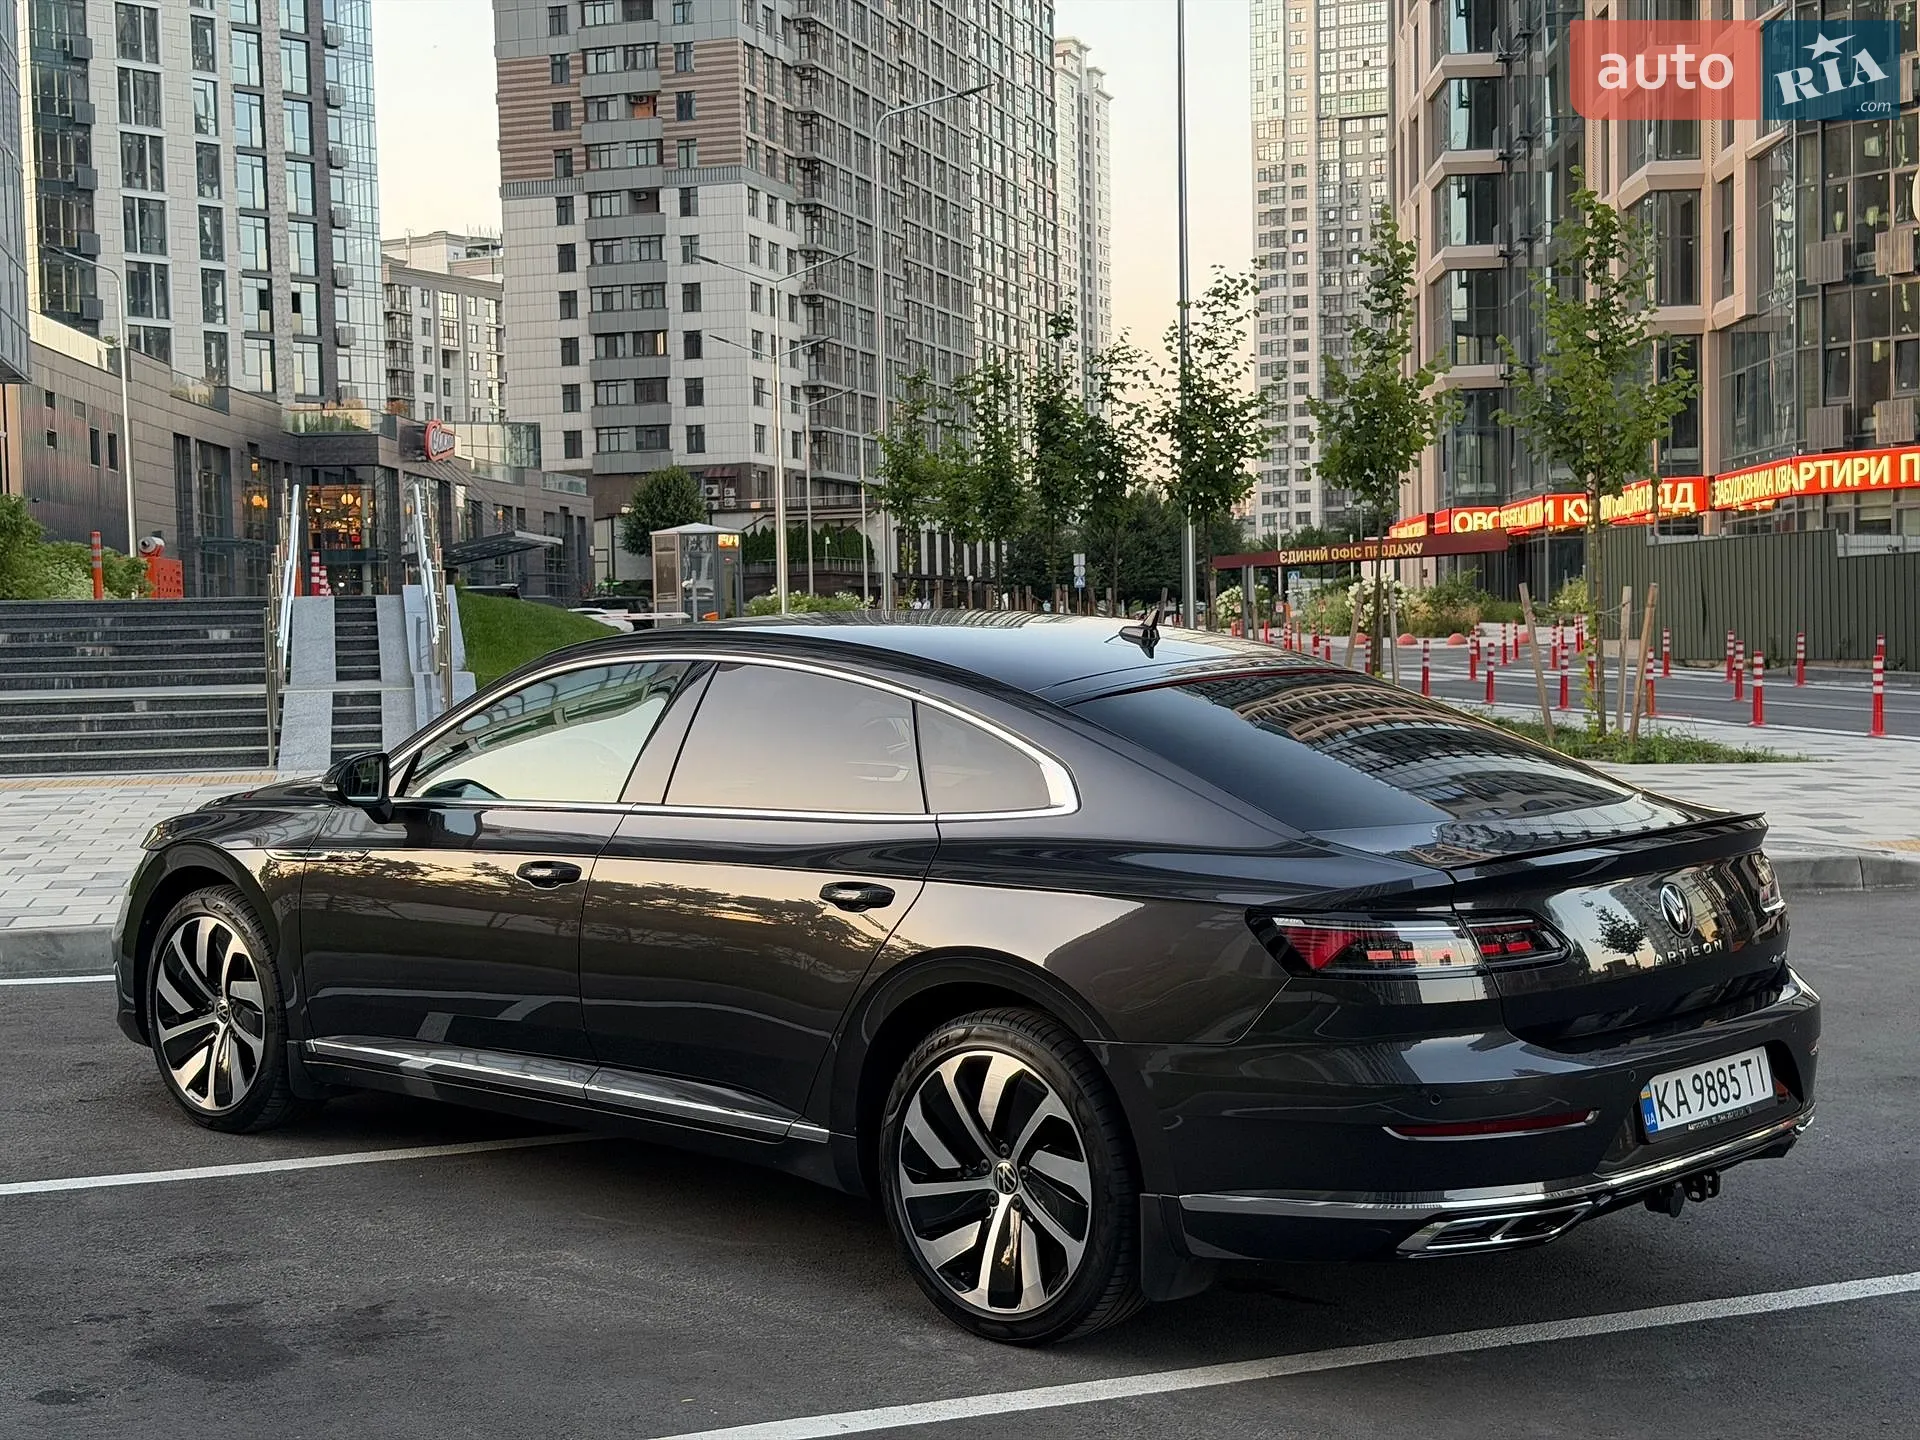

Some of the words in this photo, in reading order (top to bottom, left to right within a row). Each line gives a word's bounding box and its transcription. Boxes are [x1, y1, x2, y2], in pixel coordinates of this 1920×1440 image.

[1713, 473, 1774, 507] ЗАБУДОВНИКА
[1774, 455, 1892, 492] КВАРТИРИ
[1279, 546, 1328, 564] ЄДИНИЙ
[1331, 545, 1362, 560] ОФІС
[1364, 542, 1424, 558] ПРОДАЖУ
[1655, 940, 1723, 965] ARTEON
[1654, 1079, 1692, 1122] KA
[1691, 1063, 1742, 1112] 9885
[1740, 1055, 1766, 1097] TI
[1644, 1111, 1657, 1126] UA
